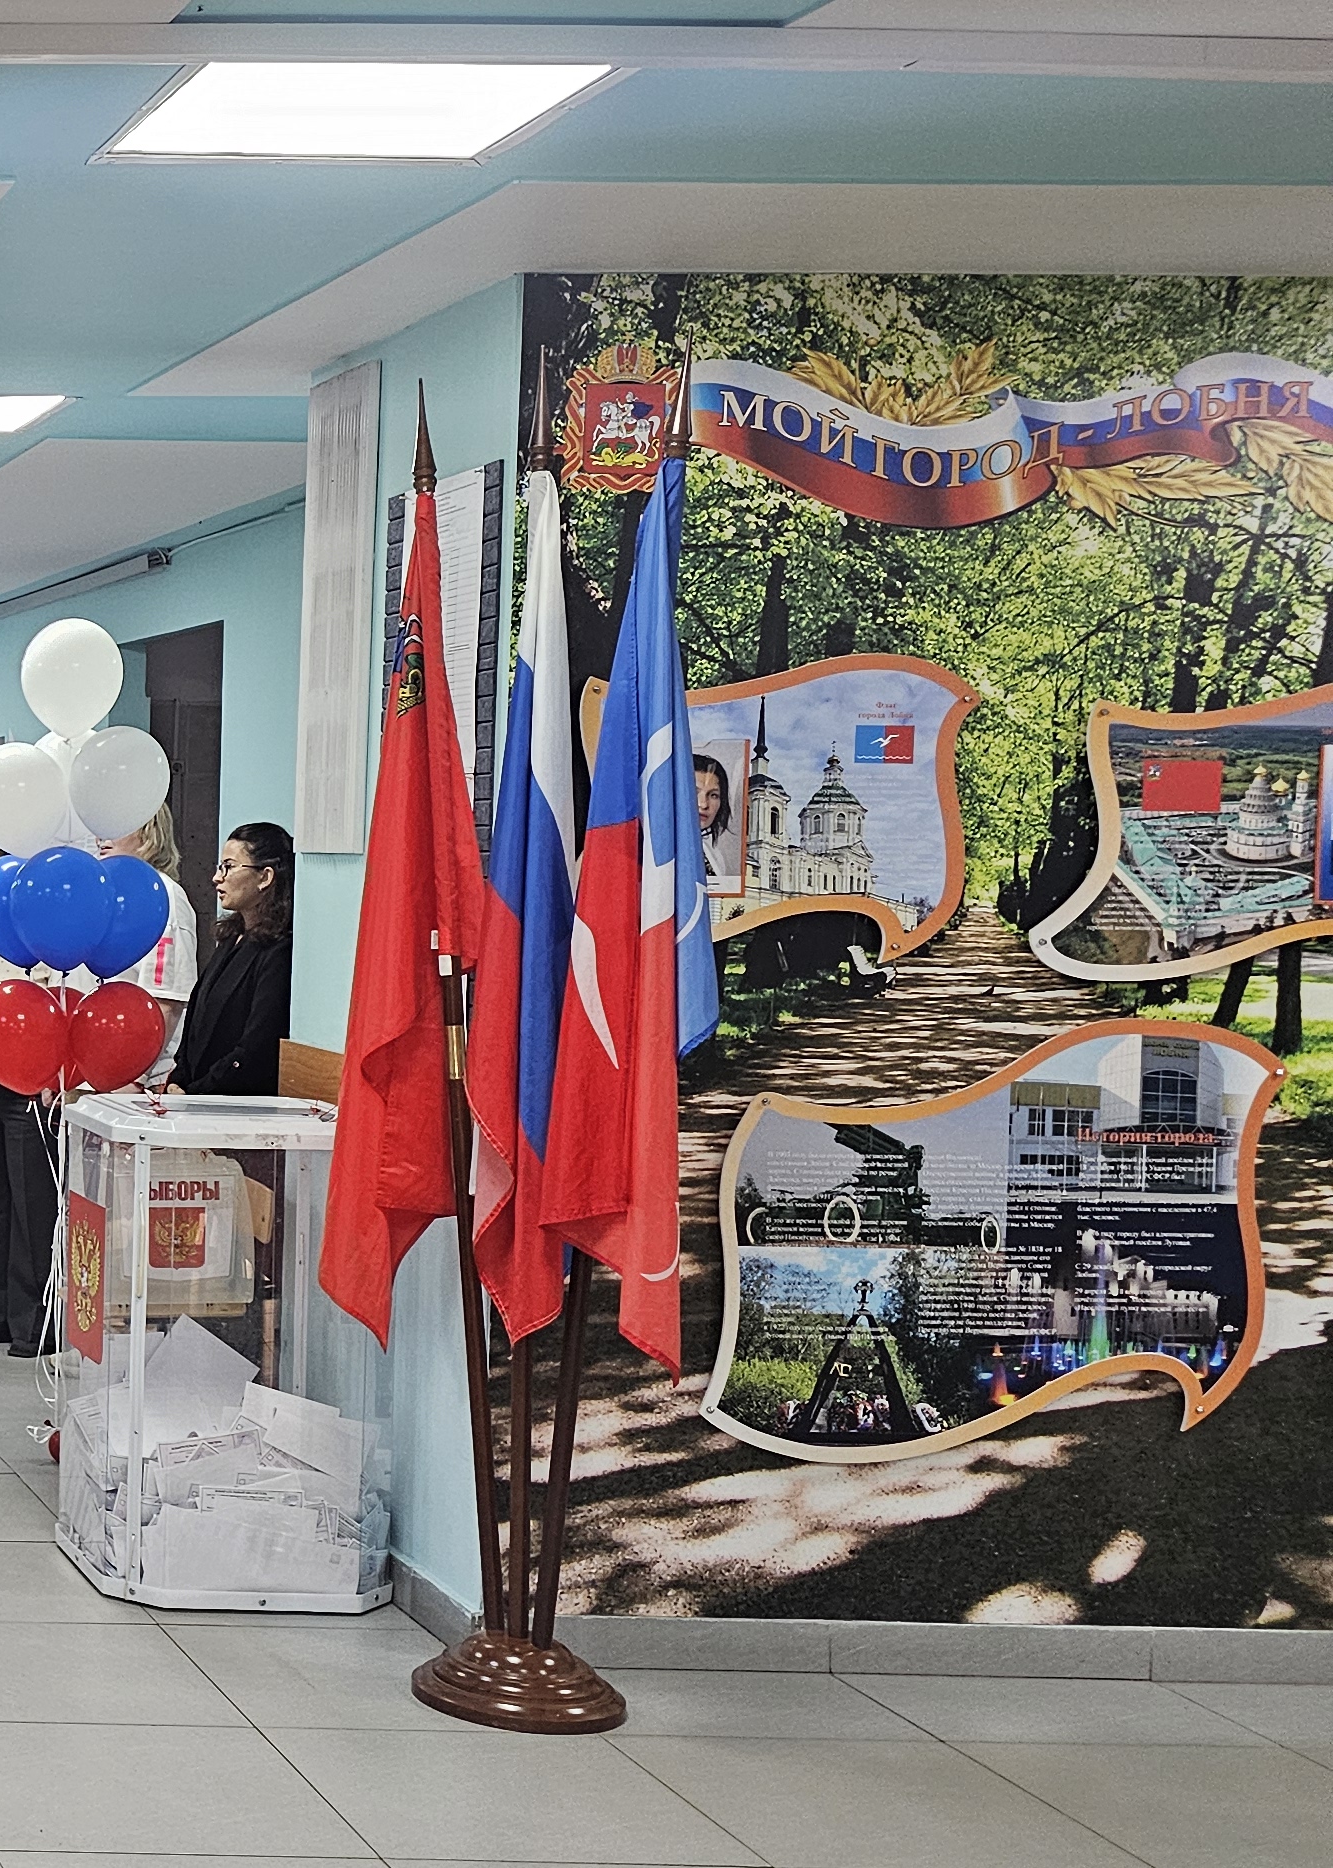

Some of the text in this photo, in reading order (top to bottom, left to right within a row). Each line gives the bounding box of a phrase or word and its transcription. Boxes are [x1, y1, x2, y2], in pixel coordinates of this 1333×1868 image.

[718, 390, 859, 466] МОЙ
[870, 420, 1067, 488] ГОРОД
[1106, 380, 1314, 439] ЛОБНЯ
[1077, 1128, 1151, 1145] История
[149, 1181, 220, 1200] ЫБОРЫ
